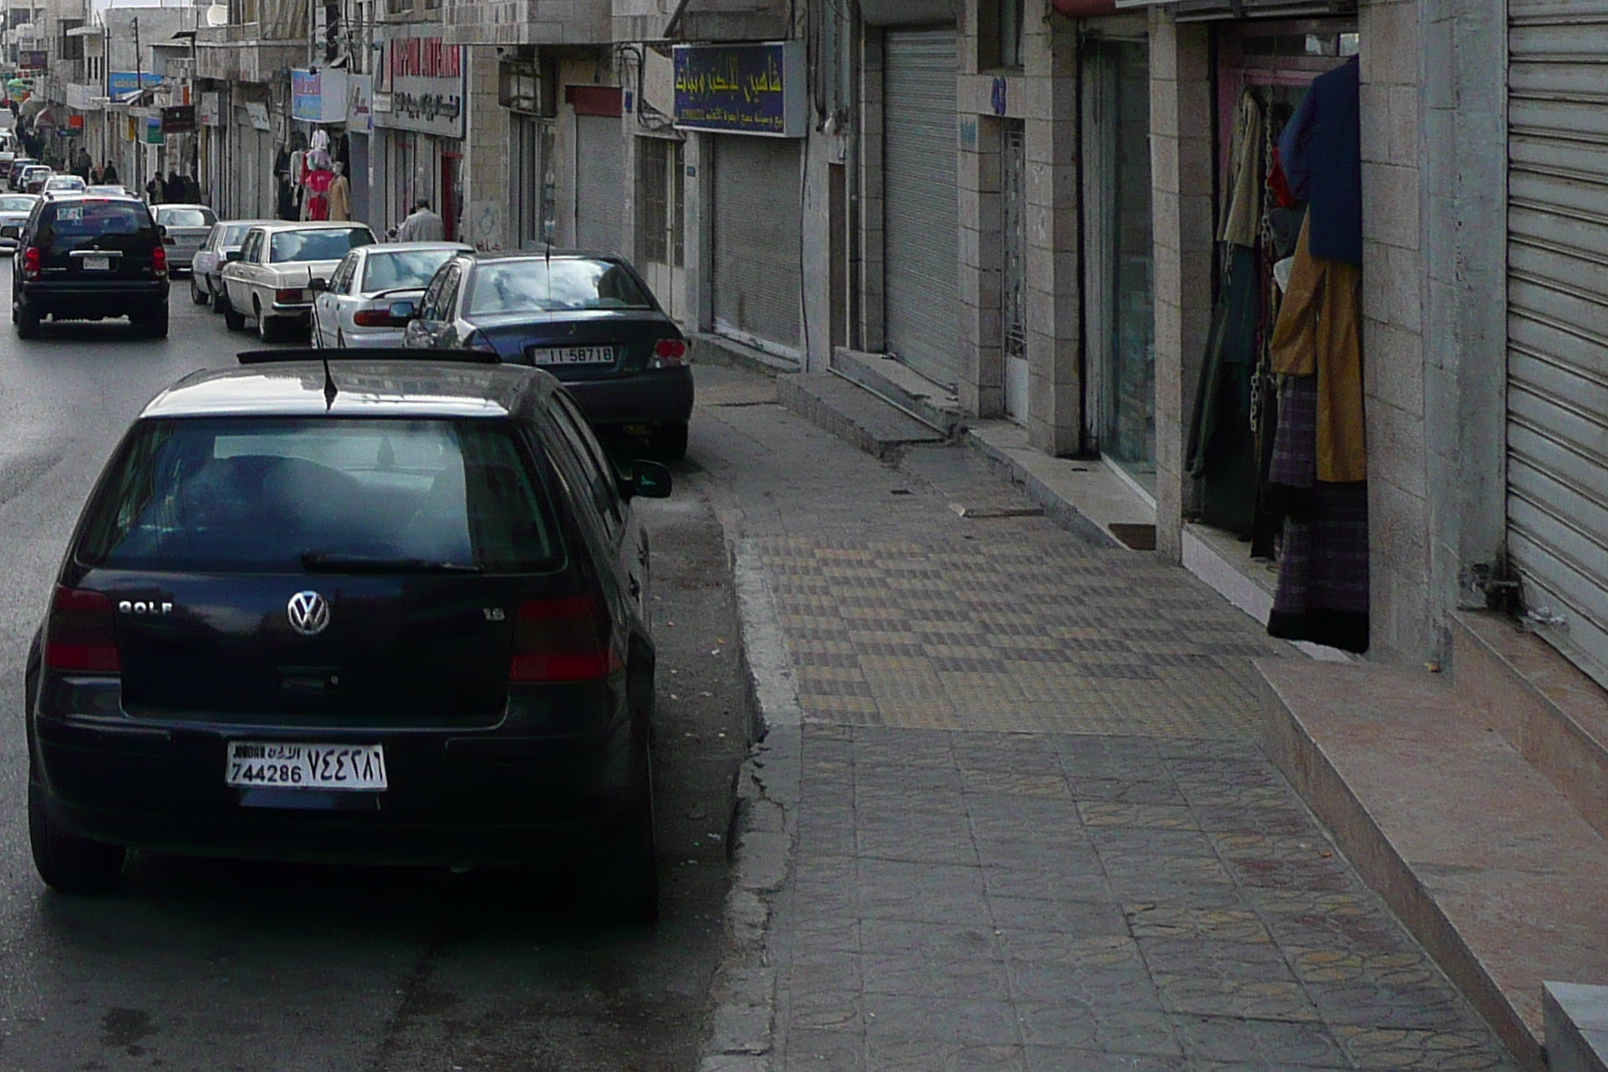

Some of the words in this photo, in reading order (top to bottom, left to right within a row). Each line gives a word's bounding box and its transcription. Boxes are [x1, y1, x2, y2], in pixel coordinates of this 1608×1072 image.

[118, 600, 174, 615] GOLF
[233, 745, 265, 759] JORDAN
[232, 763, 302, 783] 744286
[307, 749, 383, 782] ٧٤٤٢٨٦
